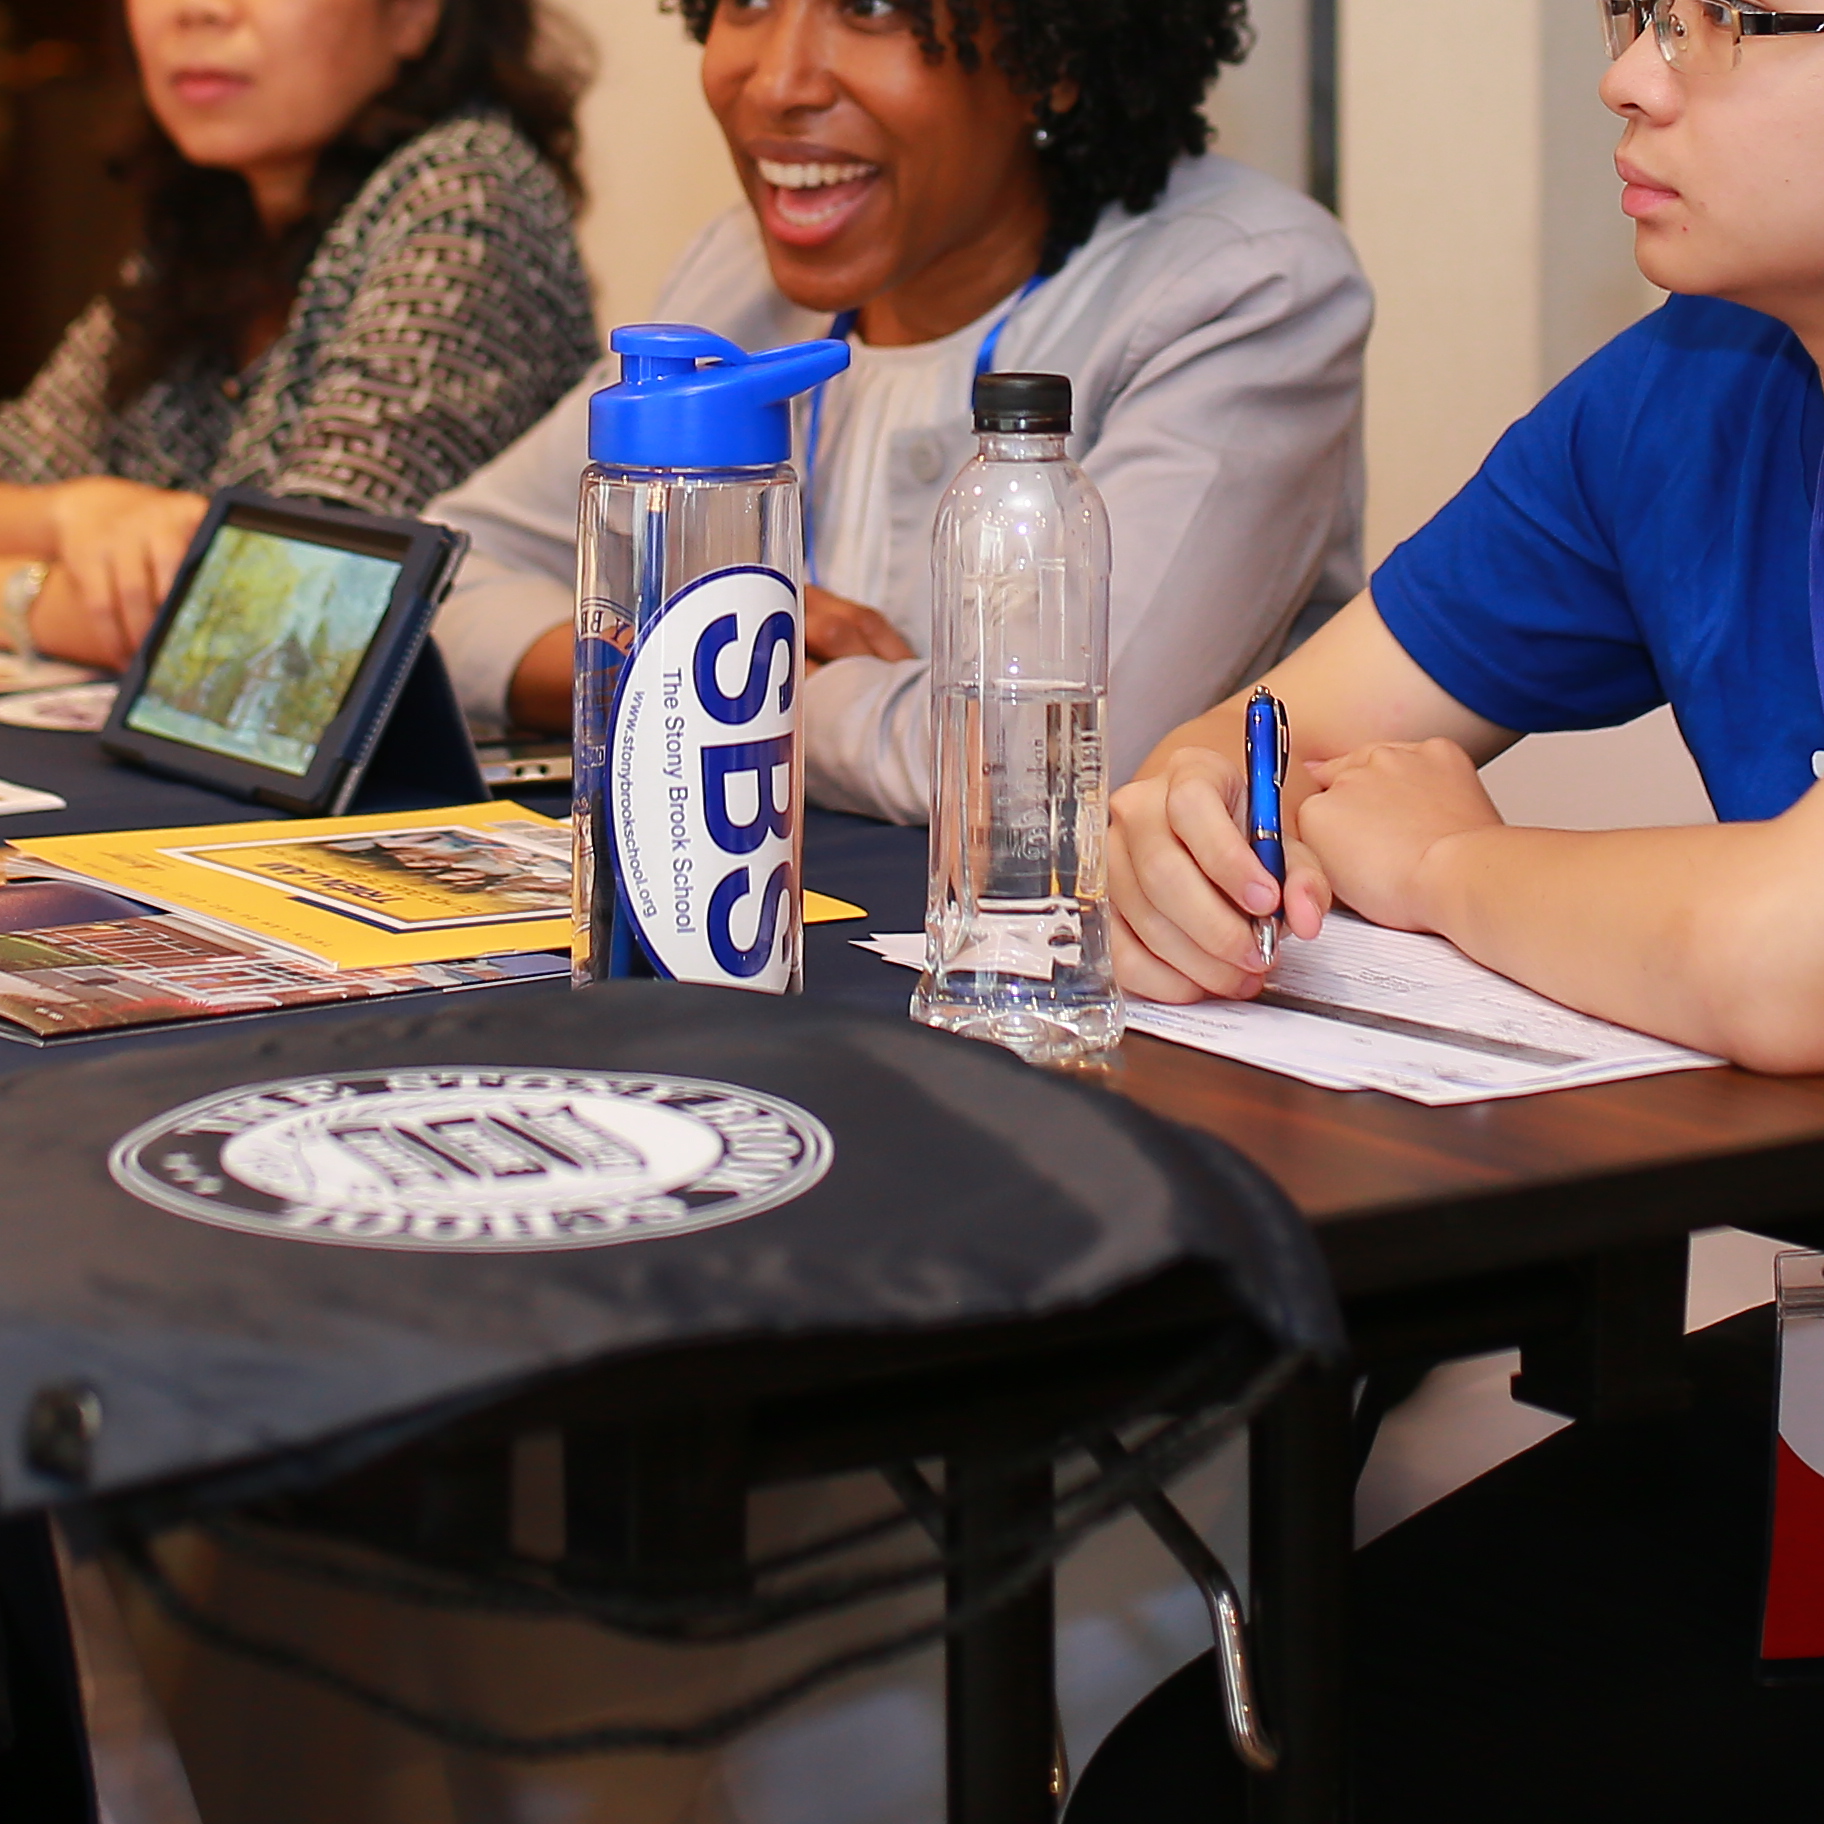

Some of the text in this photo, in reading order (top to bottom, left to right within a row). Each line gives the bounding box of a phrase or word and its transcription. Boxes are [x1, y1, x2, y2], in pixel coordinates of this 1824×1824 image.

[617, 690, 657, 918] www.stonybrookschool.org
[663, 667, 696, 934] The Stony Brook School
[692, 610, 796, 978] SBS
